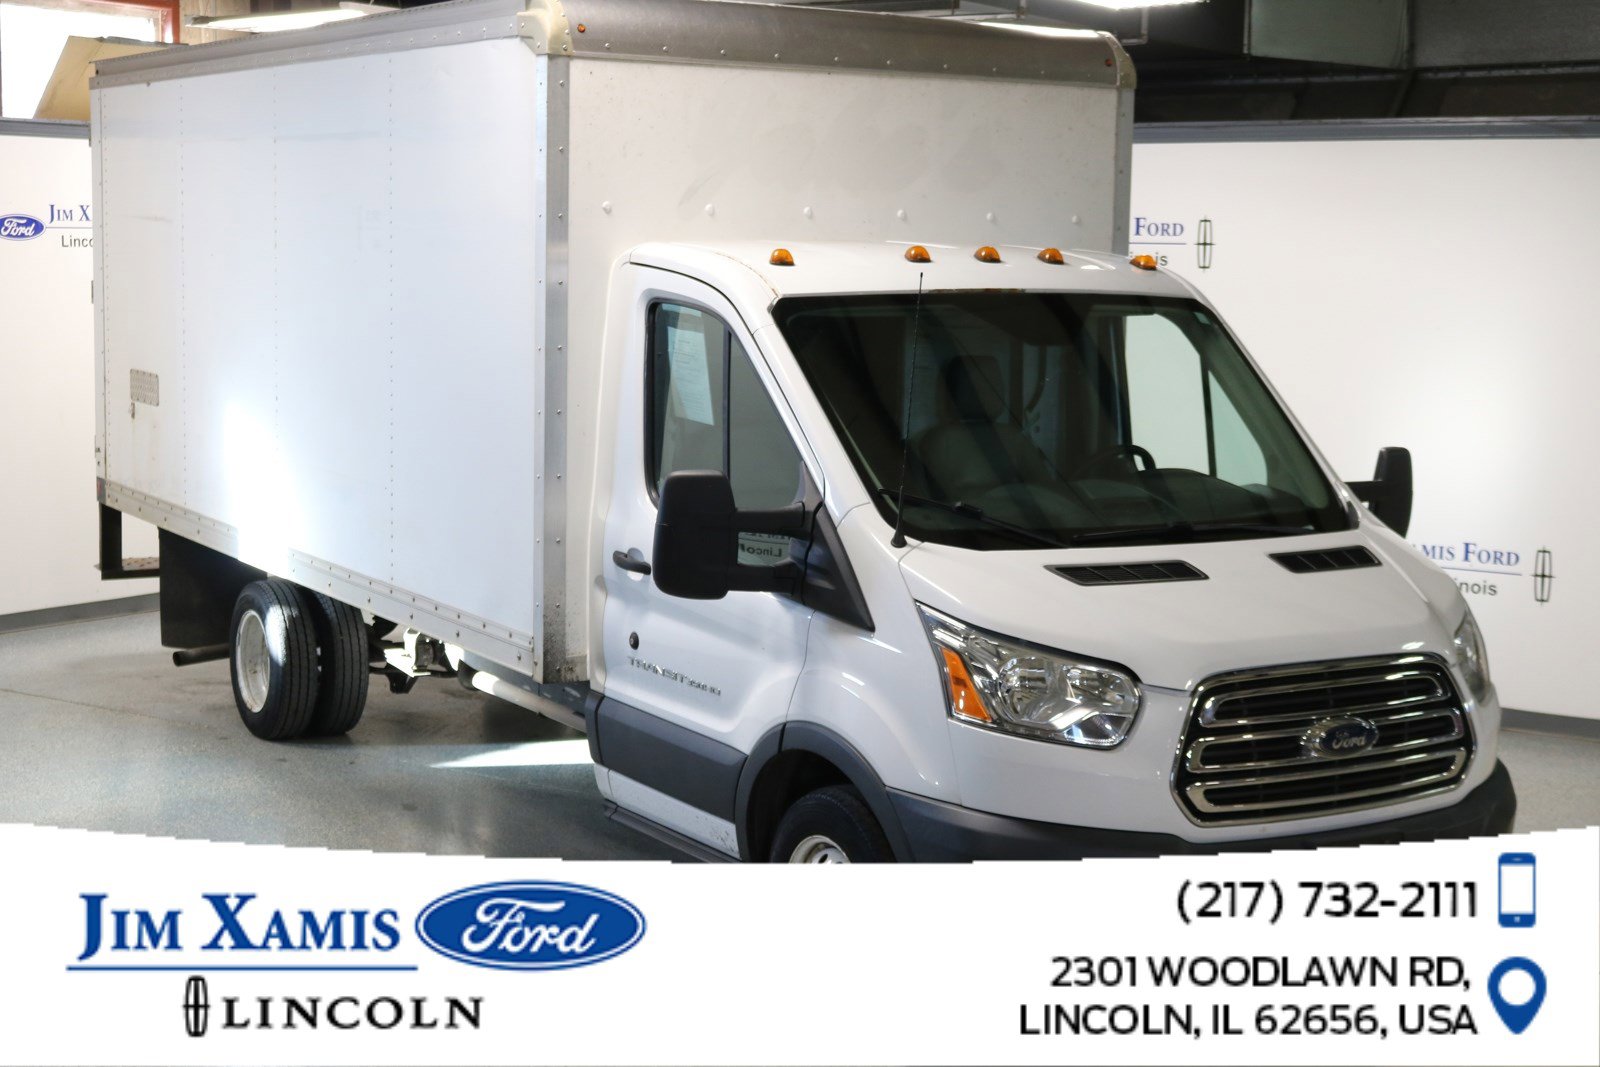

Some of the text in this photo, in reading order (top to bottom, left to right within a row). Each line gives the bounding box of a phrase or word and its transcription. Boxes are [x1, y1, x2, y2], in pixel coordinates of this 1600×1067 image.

[49, 204, 73, 224] JIM
[1, 217, 36, 236] Ford
[1134, 217, 1185, 237] FORD
[1462, 542, 1520, 567] FORD
[1332, 731, 1366, 750] Ford
